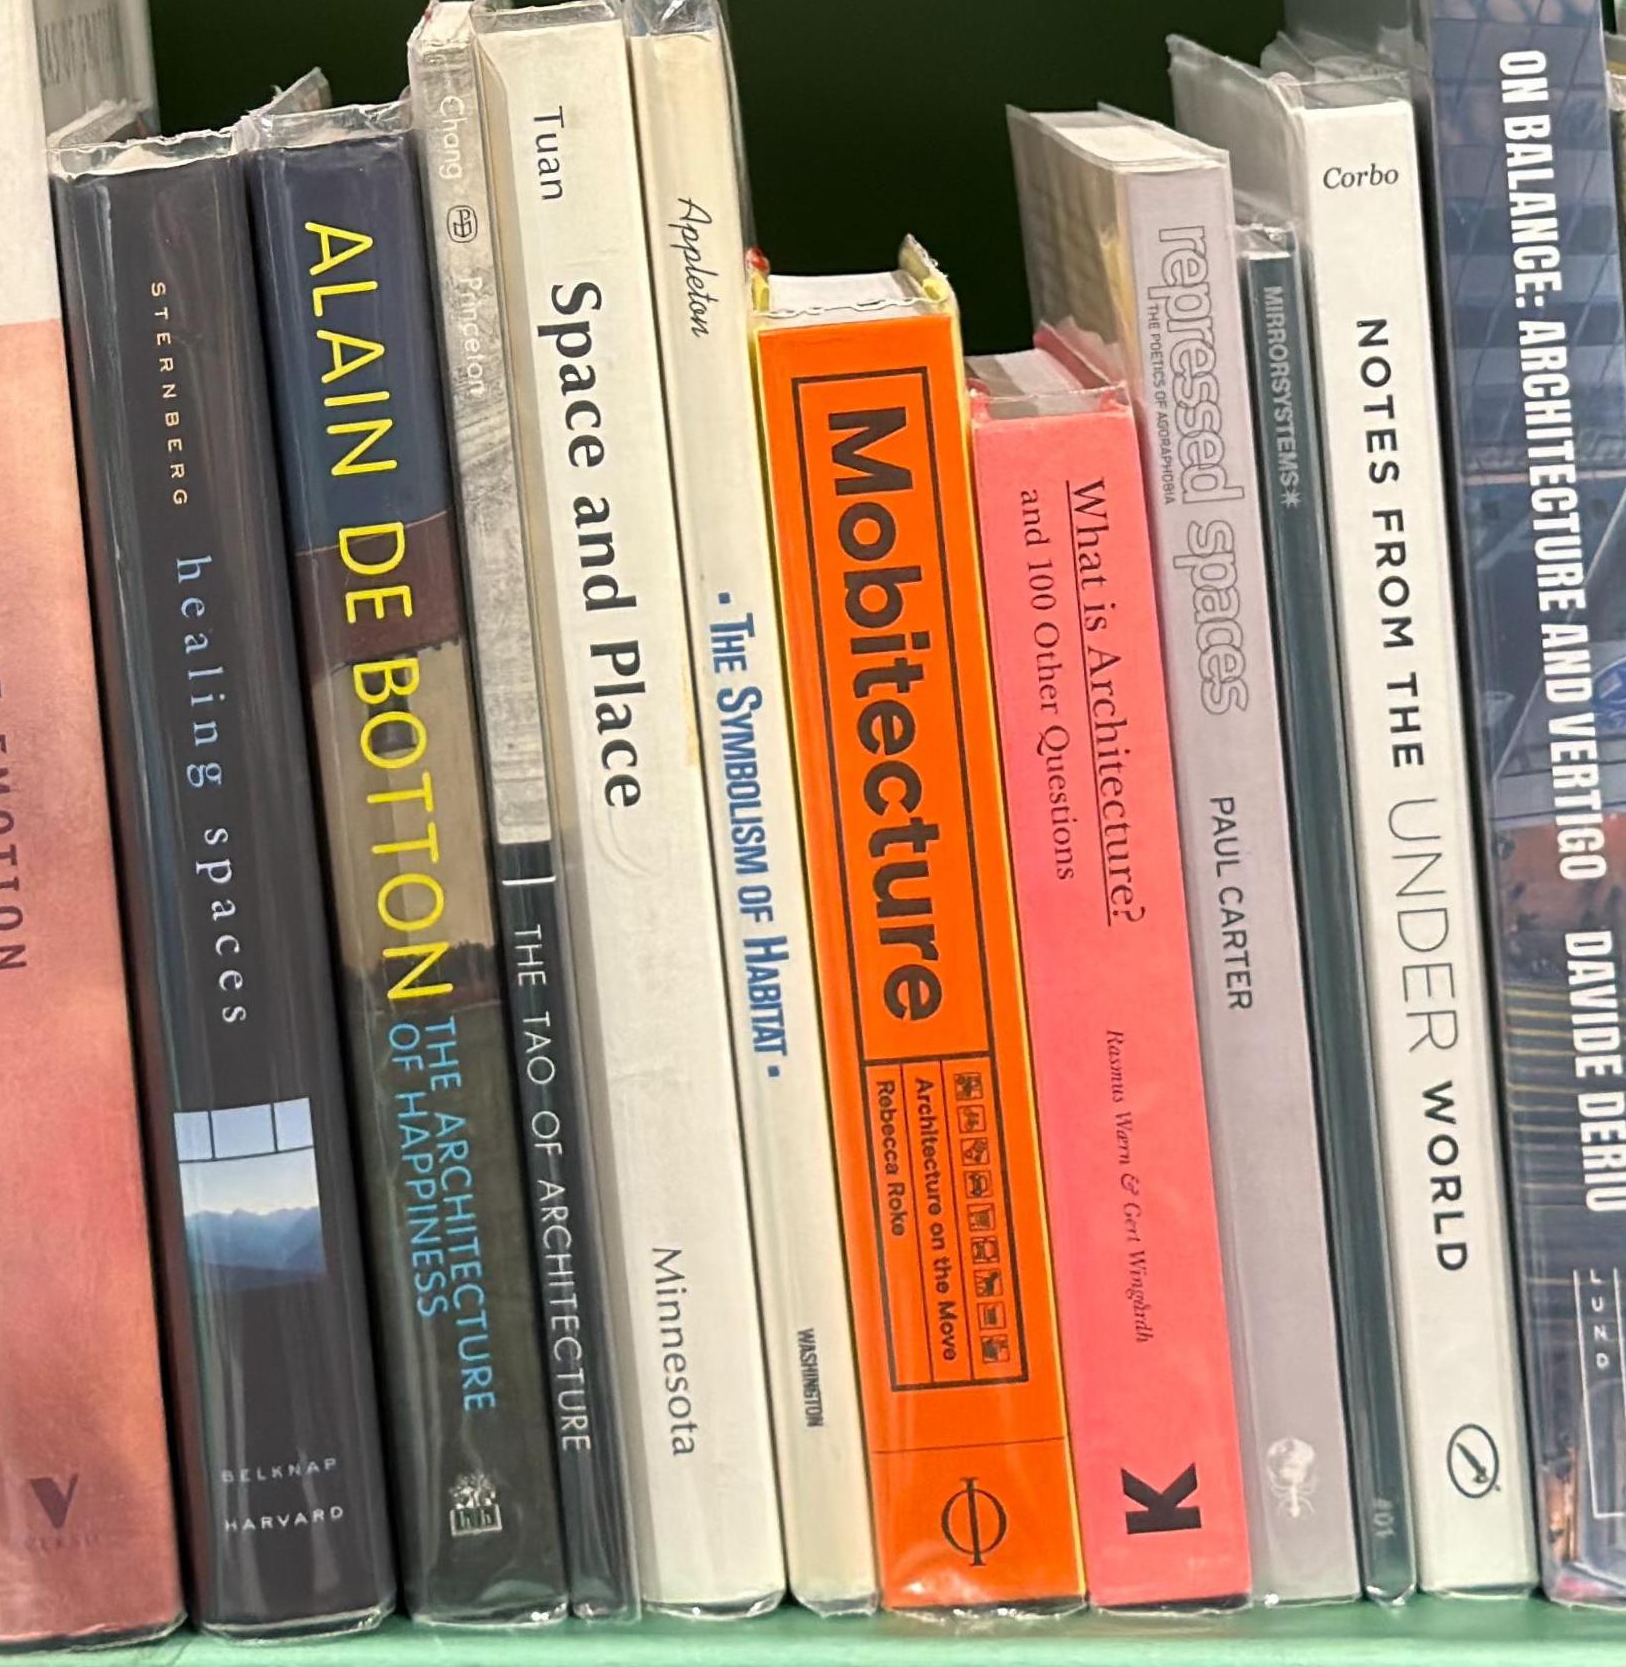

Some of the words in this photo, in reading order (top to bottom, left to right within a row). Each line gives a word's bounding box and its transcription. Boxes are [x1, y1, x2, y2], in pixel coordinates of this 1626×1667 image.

[1498, 50, 1548, 104] ON
[439, 95, 469, 180] Chang
[533, 104, 563, 202] Tuan
[1322, 164, 1401, 190] Corbo
[1504, 114, 1564, 309] BALANCE:
[665, 197, 719, 338] Appleton
[1147, 305, 1160, 330] THE
[149, 281, 188, 506] STERNBERG
[304, 221, 398, 477] ALAIN
[537, 281, 605, 470] Space
[1147, 226, 1245, 504] repressed
[1151, 332, 1164, 389] POETICS
[1155, 391, 1167, 408] OF
[1355, 317, 1401, 486] NOTES
[1157, 413, 1177, 505] AGORAPHOBIA
[1519, 320, 1587, 613] ARCHITECTURE
[572, 496, 637, 612] and
[1020, 489, 1051, 550] and
[1072, 477, 1111, 590] What
[339, 521, 413, 624] DE
[1027, 559, 1058, 616] 100
[1083, 598, 1117, 633] is
[1173, 520, 1248, 716] spaces
[1372, 510, 1414, 648] FROM
[176, 556, 225, 789] healing
[710, 613, 754, 673] THE
[1031, 620, 1063, 715] Other
[1540, 622, 1593, 703] AND
[590, 639, 646, 808] Place
[826, 404, 944, 1022] Mobitecture
[1385, 673, 1424, 770] THE
[352, 656, 453, 1001] BOTTON
[717, 686, 768, 876] SYMBOLISM
[1035, 723, 1078, 881] Questions
[1087, 646, 1146, 927] Architecture?
[1548, 711, 1609, 882] VERTIGO
[1208, 797, 1242, 878] PAUL
[195, 827, 247, 1026] spaces
[736, 885, 774, 923] OF
[1218, 886, 1254, 1012] CARTER
[1386, 799, 1459, 1054] UNDER
[512, 922, 548, 988] THE
[743, 934, 790, 1062] HABITAT
[1564, 929, 1623, 1078] DAVIDE
[387, 1021, 422, 1074] OF
[423, 1017, 463, 1090] THE
[520, 1012, 558, 1088] TAO
[1105, 1029, 1125, 1103] Rasmus
[528, 1109, 562, 1163] OF
[876, 1079, 899, 1176] Rebecca
[913, 1076, 943, 1216] Architecture
[1421, 1079, 1469, 1272] WORLD
[394, 1090, 450, 1321] HAPPINESS
[887, 1183, 906, 1236] Roke
[1121, 1174, 1140, 1197] &
[1123, 1201, 1142, 1243] Gert
[434, 1107, 496, 1413] ARCHITECTURE
[930, 1222, 948, 1250] on
[933, 1256, 952, 1294] the
[536, 1179, 590, 1452] ARCHITECTURE
[650, 1246, 695, 1458] Minnesota
[936, 1300, 958, 1362] Move
[797, 1328, 824, 1428] WASHINGTON
[220, 1455, 339, 1483] BELKNAP
[223, 1505, 344, 1533] HARVARD
